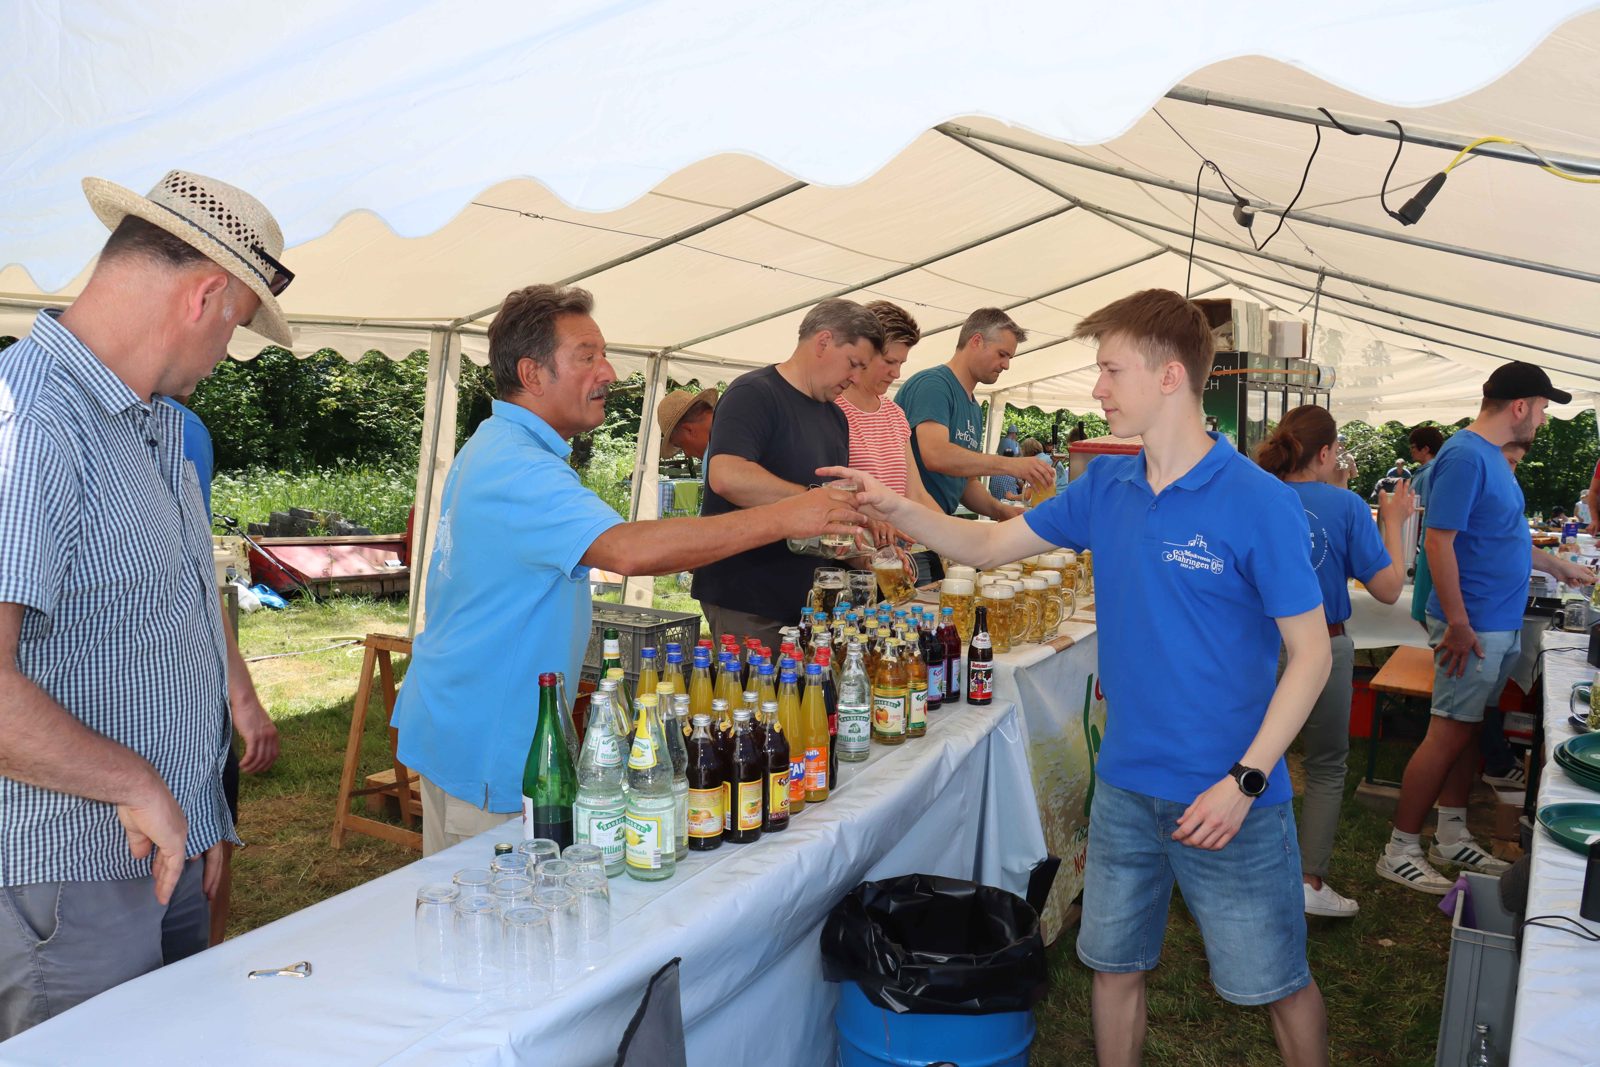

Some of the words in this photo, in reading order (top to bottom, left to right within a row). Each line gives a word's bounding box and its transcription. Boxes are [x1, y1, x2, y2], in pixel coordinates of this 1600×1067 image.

[1162, 549, 1210, 570] Stahringen
[806, 749, 820, 757] ANTA
[789, 762, 805, 777] FAN
